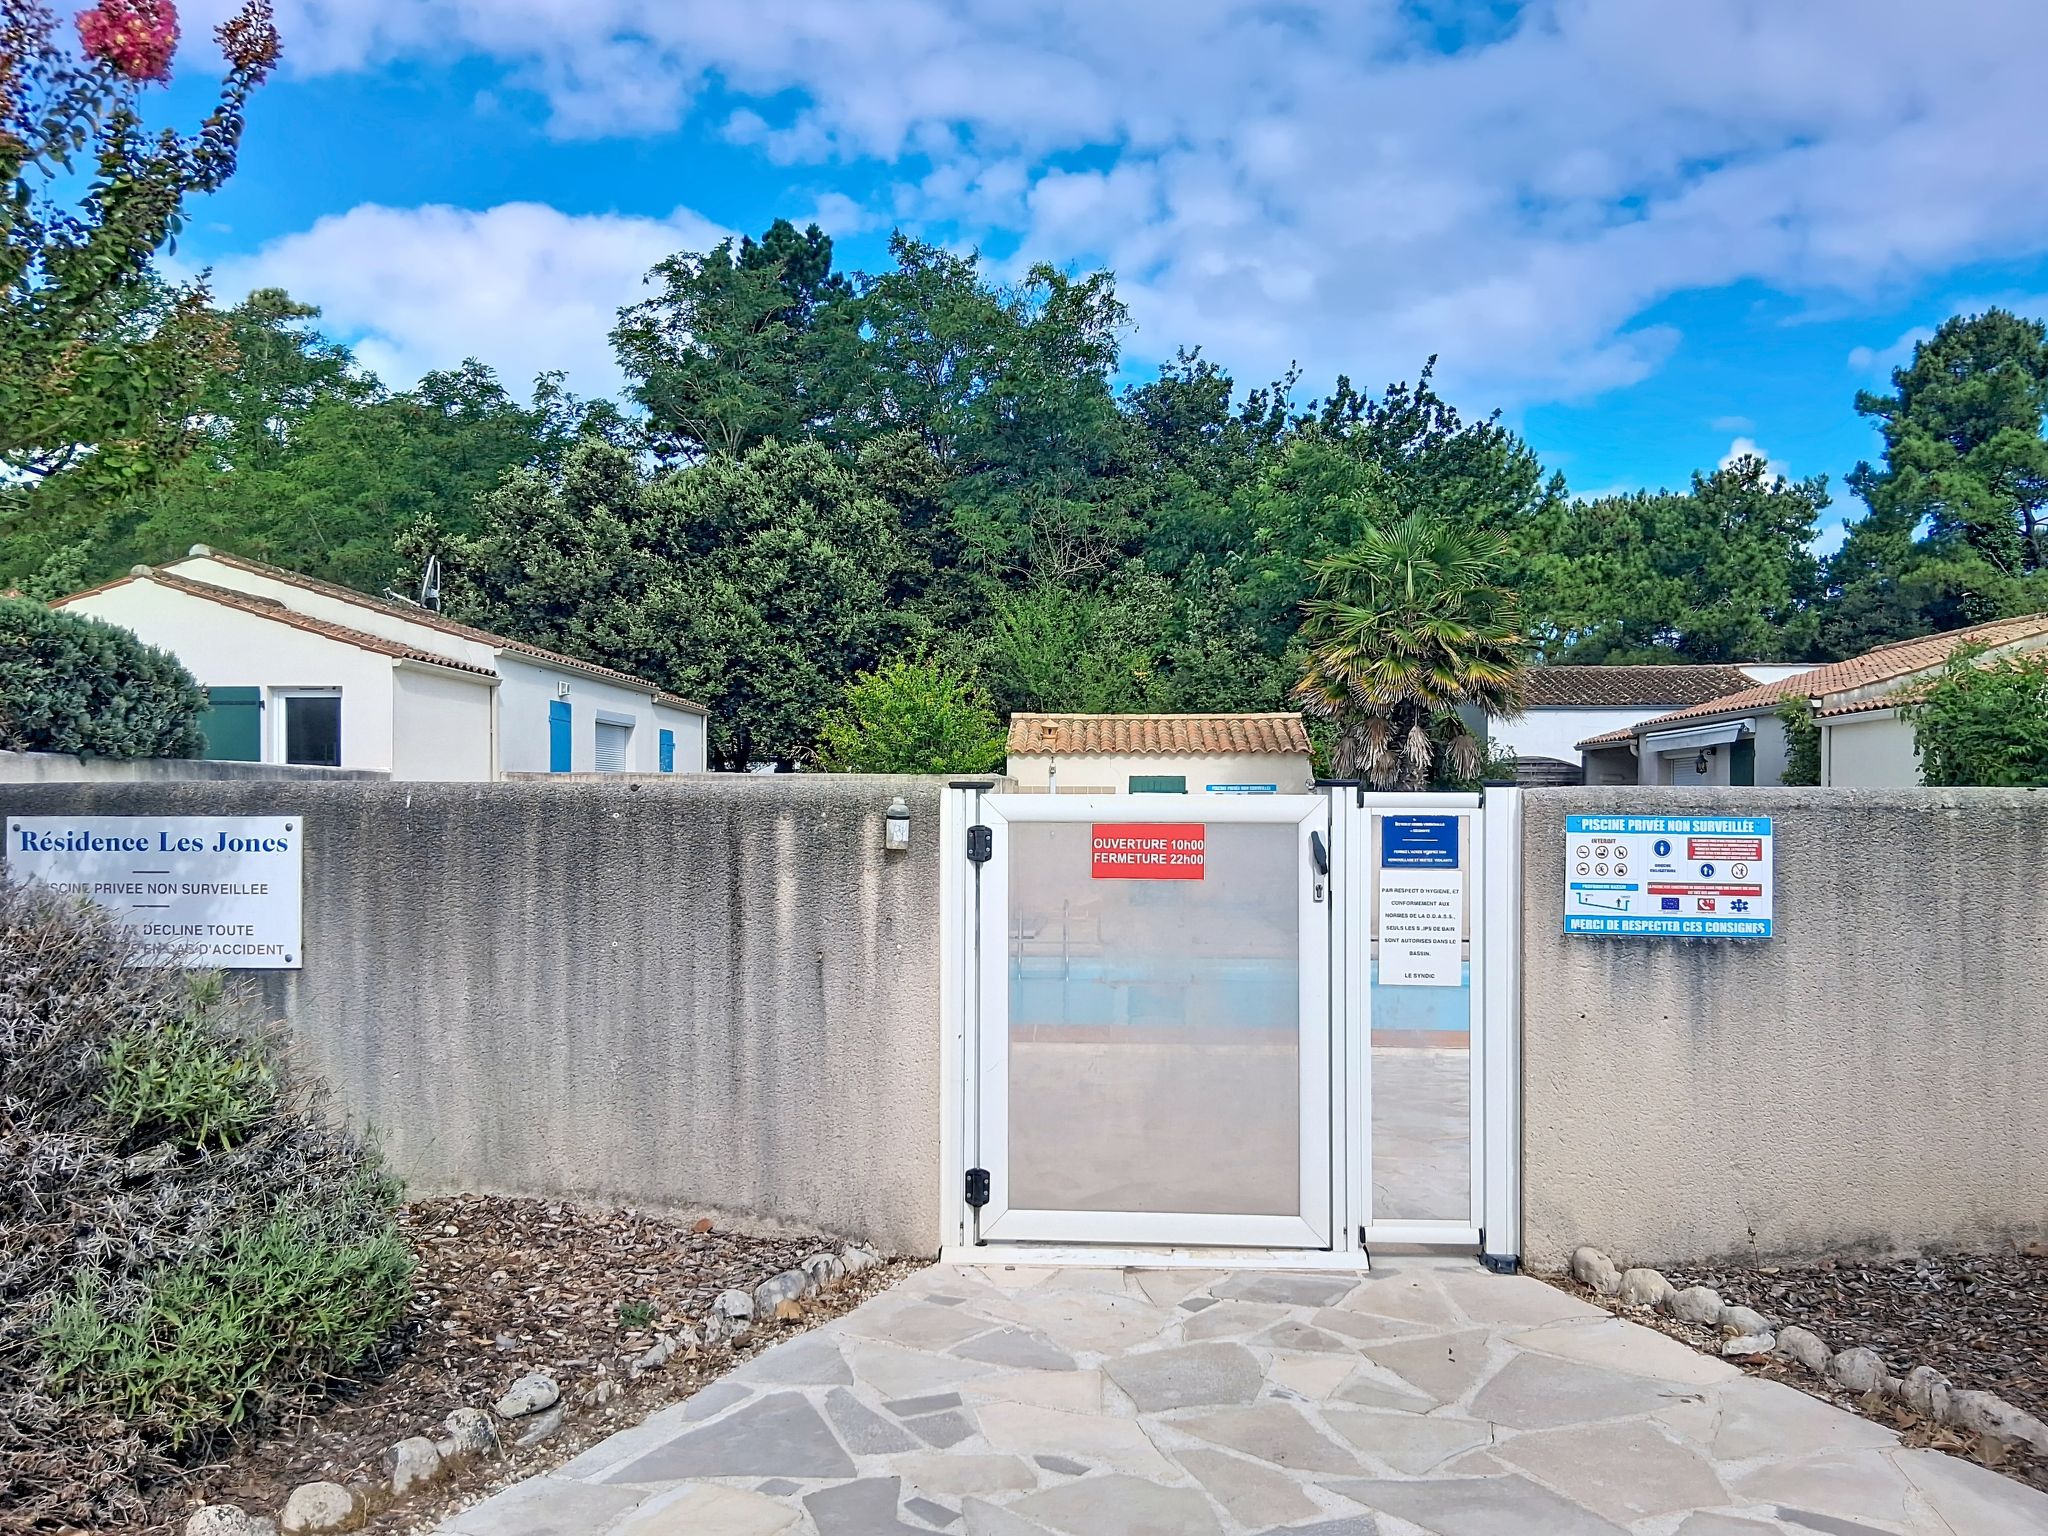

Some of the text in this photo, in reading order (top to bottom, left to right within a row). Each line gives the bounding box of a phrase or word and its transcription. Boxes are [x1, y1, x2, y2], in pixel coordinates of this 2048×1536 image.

[1582, 818, 1754, 832] PISCINE PRIVÉE NON SURVEILLÉE
[21, 830, 288, 853] Résidence Les Joncs
[1093, 839, 1204, 850] OUVERTURE 10h00
[1094, 853, 1204, 864] FERMETURE 22h00
[95, 883, 143, 894] PRIVEE
[147, 883, 177, 894] NON
[182, 884, 268, 894] SURVEILLEE
[144, 924, 203, 935] DECLINE
[207, 925, 254, 936] TOUTE
[1571, 919, 1765, 933] MERCI DE RESPECTER CES CONSIGNES
[199, 944, 285, 955] D'ACCIDENT
